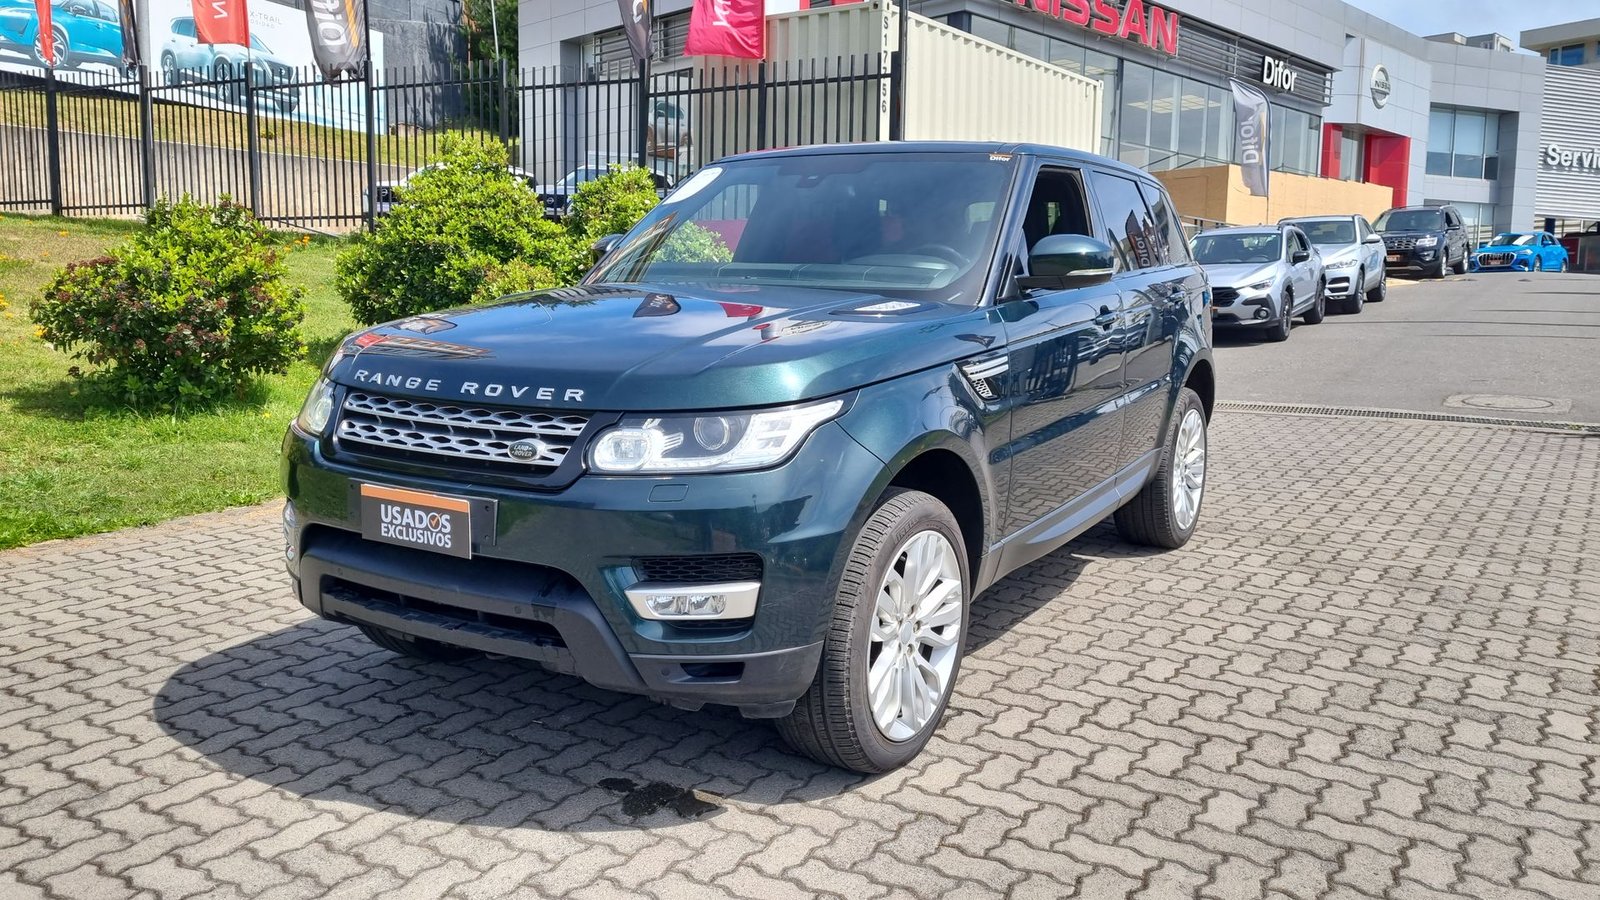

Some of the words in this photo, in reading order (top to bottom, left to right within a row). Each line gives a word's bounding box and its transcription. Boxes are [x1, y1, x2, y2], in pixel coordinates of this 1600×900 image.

[1263, 56, 1297, 91] Difor
[1546, 144, 1600, 169] Servi
[354, 369, 442, 392] RANGE
[460, 381, 585, 402] ROVER
[380, 503, 451, 533] USADOS
[381, 523, 452, 549] EXCLUSIVOS
